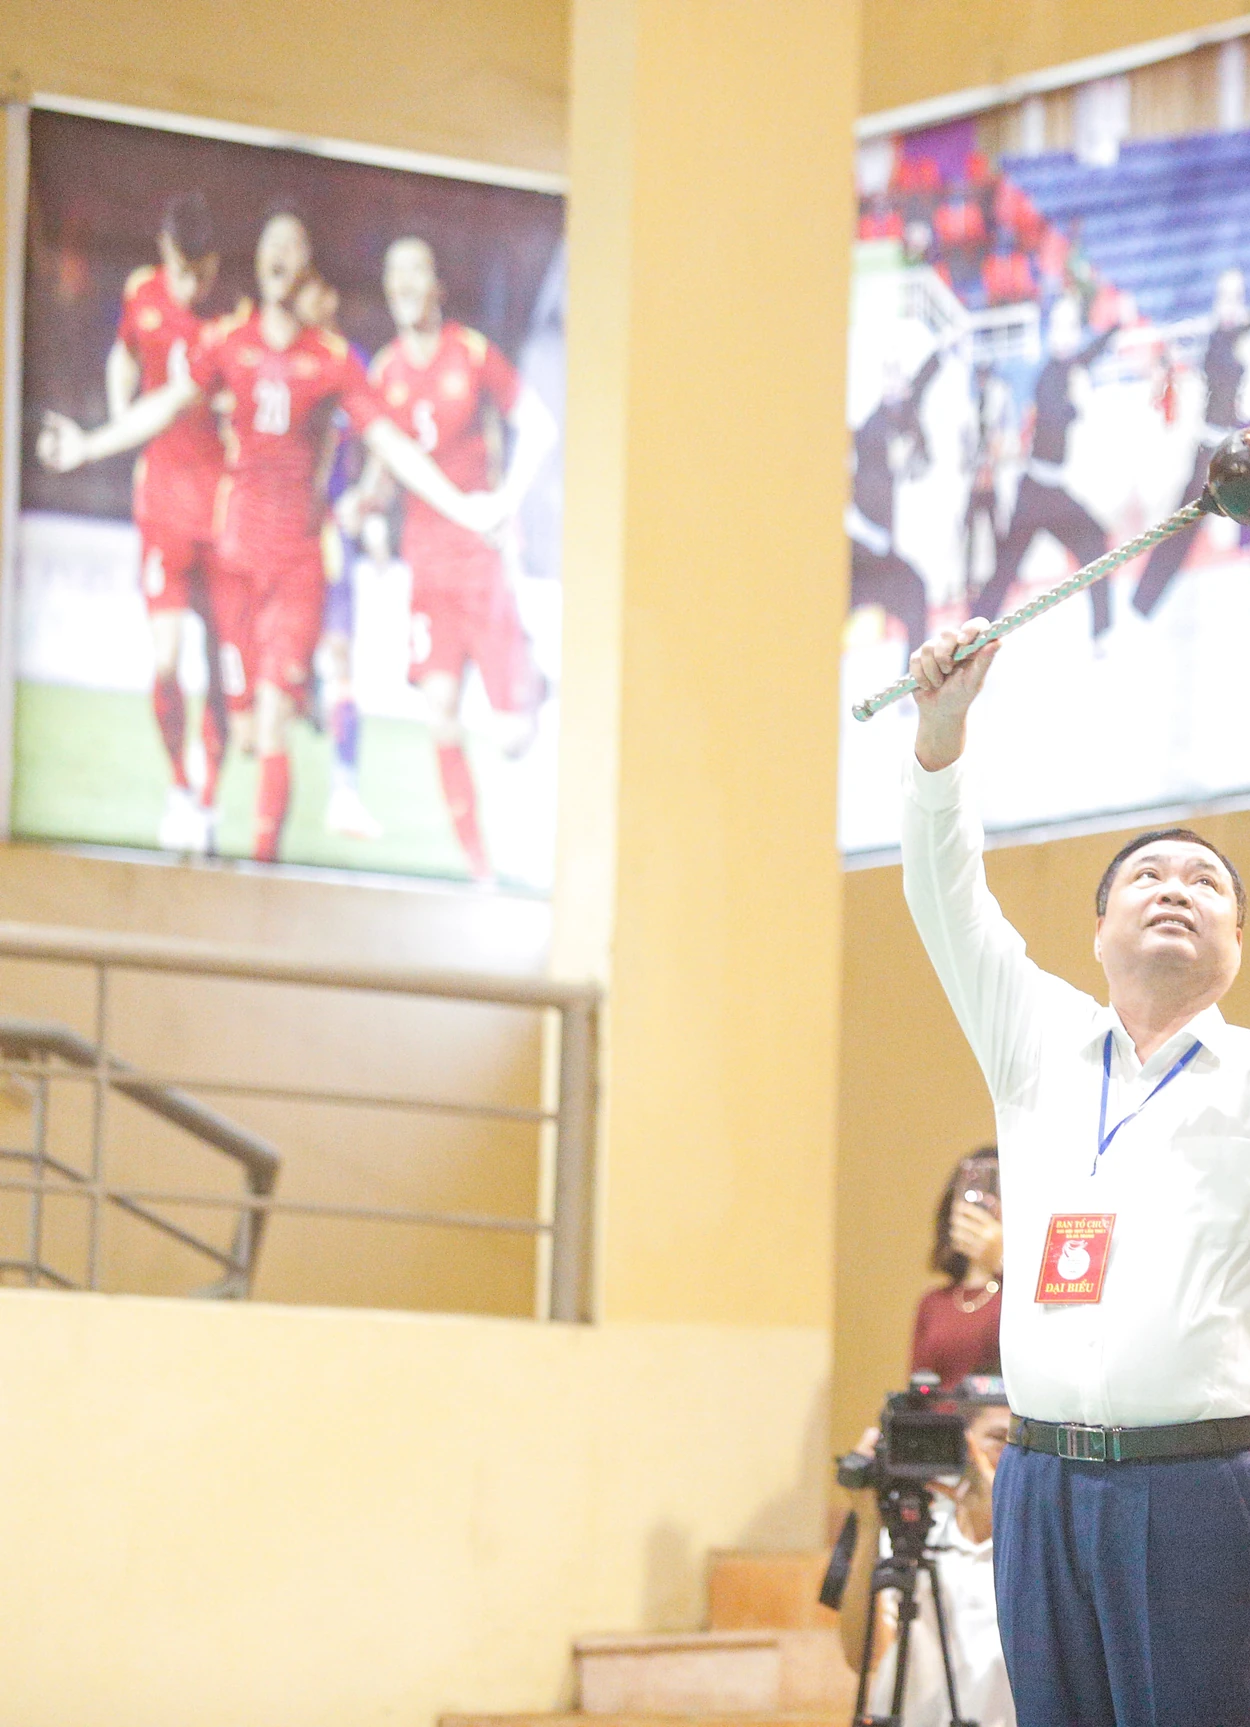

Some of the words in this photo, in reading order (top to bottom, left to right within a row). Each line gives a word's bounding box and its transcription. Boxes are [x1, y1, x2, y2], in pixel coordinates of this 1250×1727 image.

[1056, 1220, 1073, 1229] BAN
[1075, 1217, 1086, 1229] TỔ
[1045, 1283, 1065, 1295] ĐẠI
[1067, 1279, 1094, 1293] BIỂU
